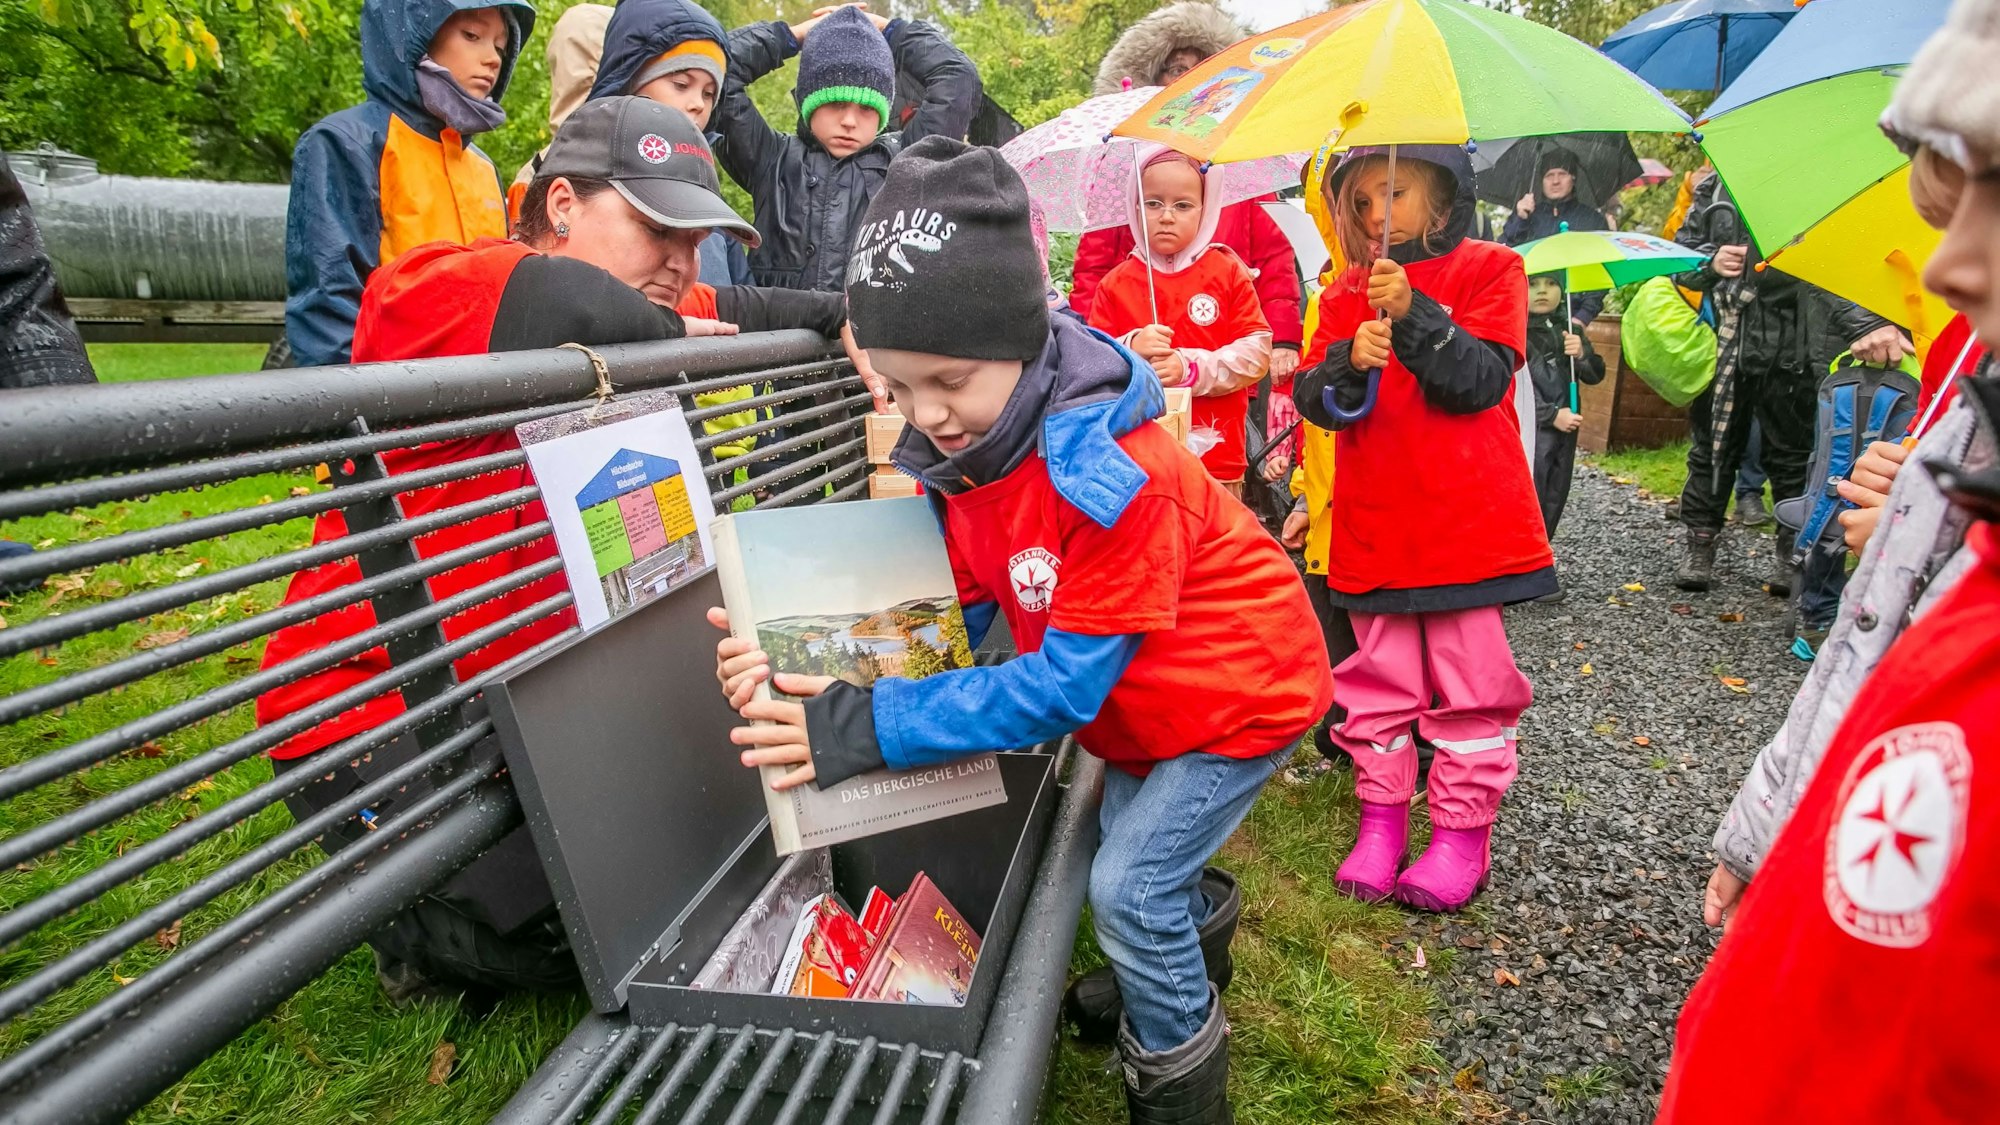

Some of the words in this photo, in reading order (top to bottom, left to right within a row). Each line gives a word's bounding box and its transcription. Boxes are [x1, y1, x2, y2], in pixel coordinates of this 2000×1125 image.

[841, 785, 869, 803] DAS
[873, 768, 954, 797] BERGISCHE
[957, 758, 995, 777] LAND
[802, 821, 861, 839] MONOGRAPHIEN
[863, 812, 901, 824] DEUTSCHER
[903, 794, 973, 814] WIRTSCHAFTSGEBIETE
[976, 788, 993, 798] BAND
